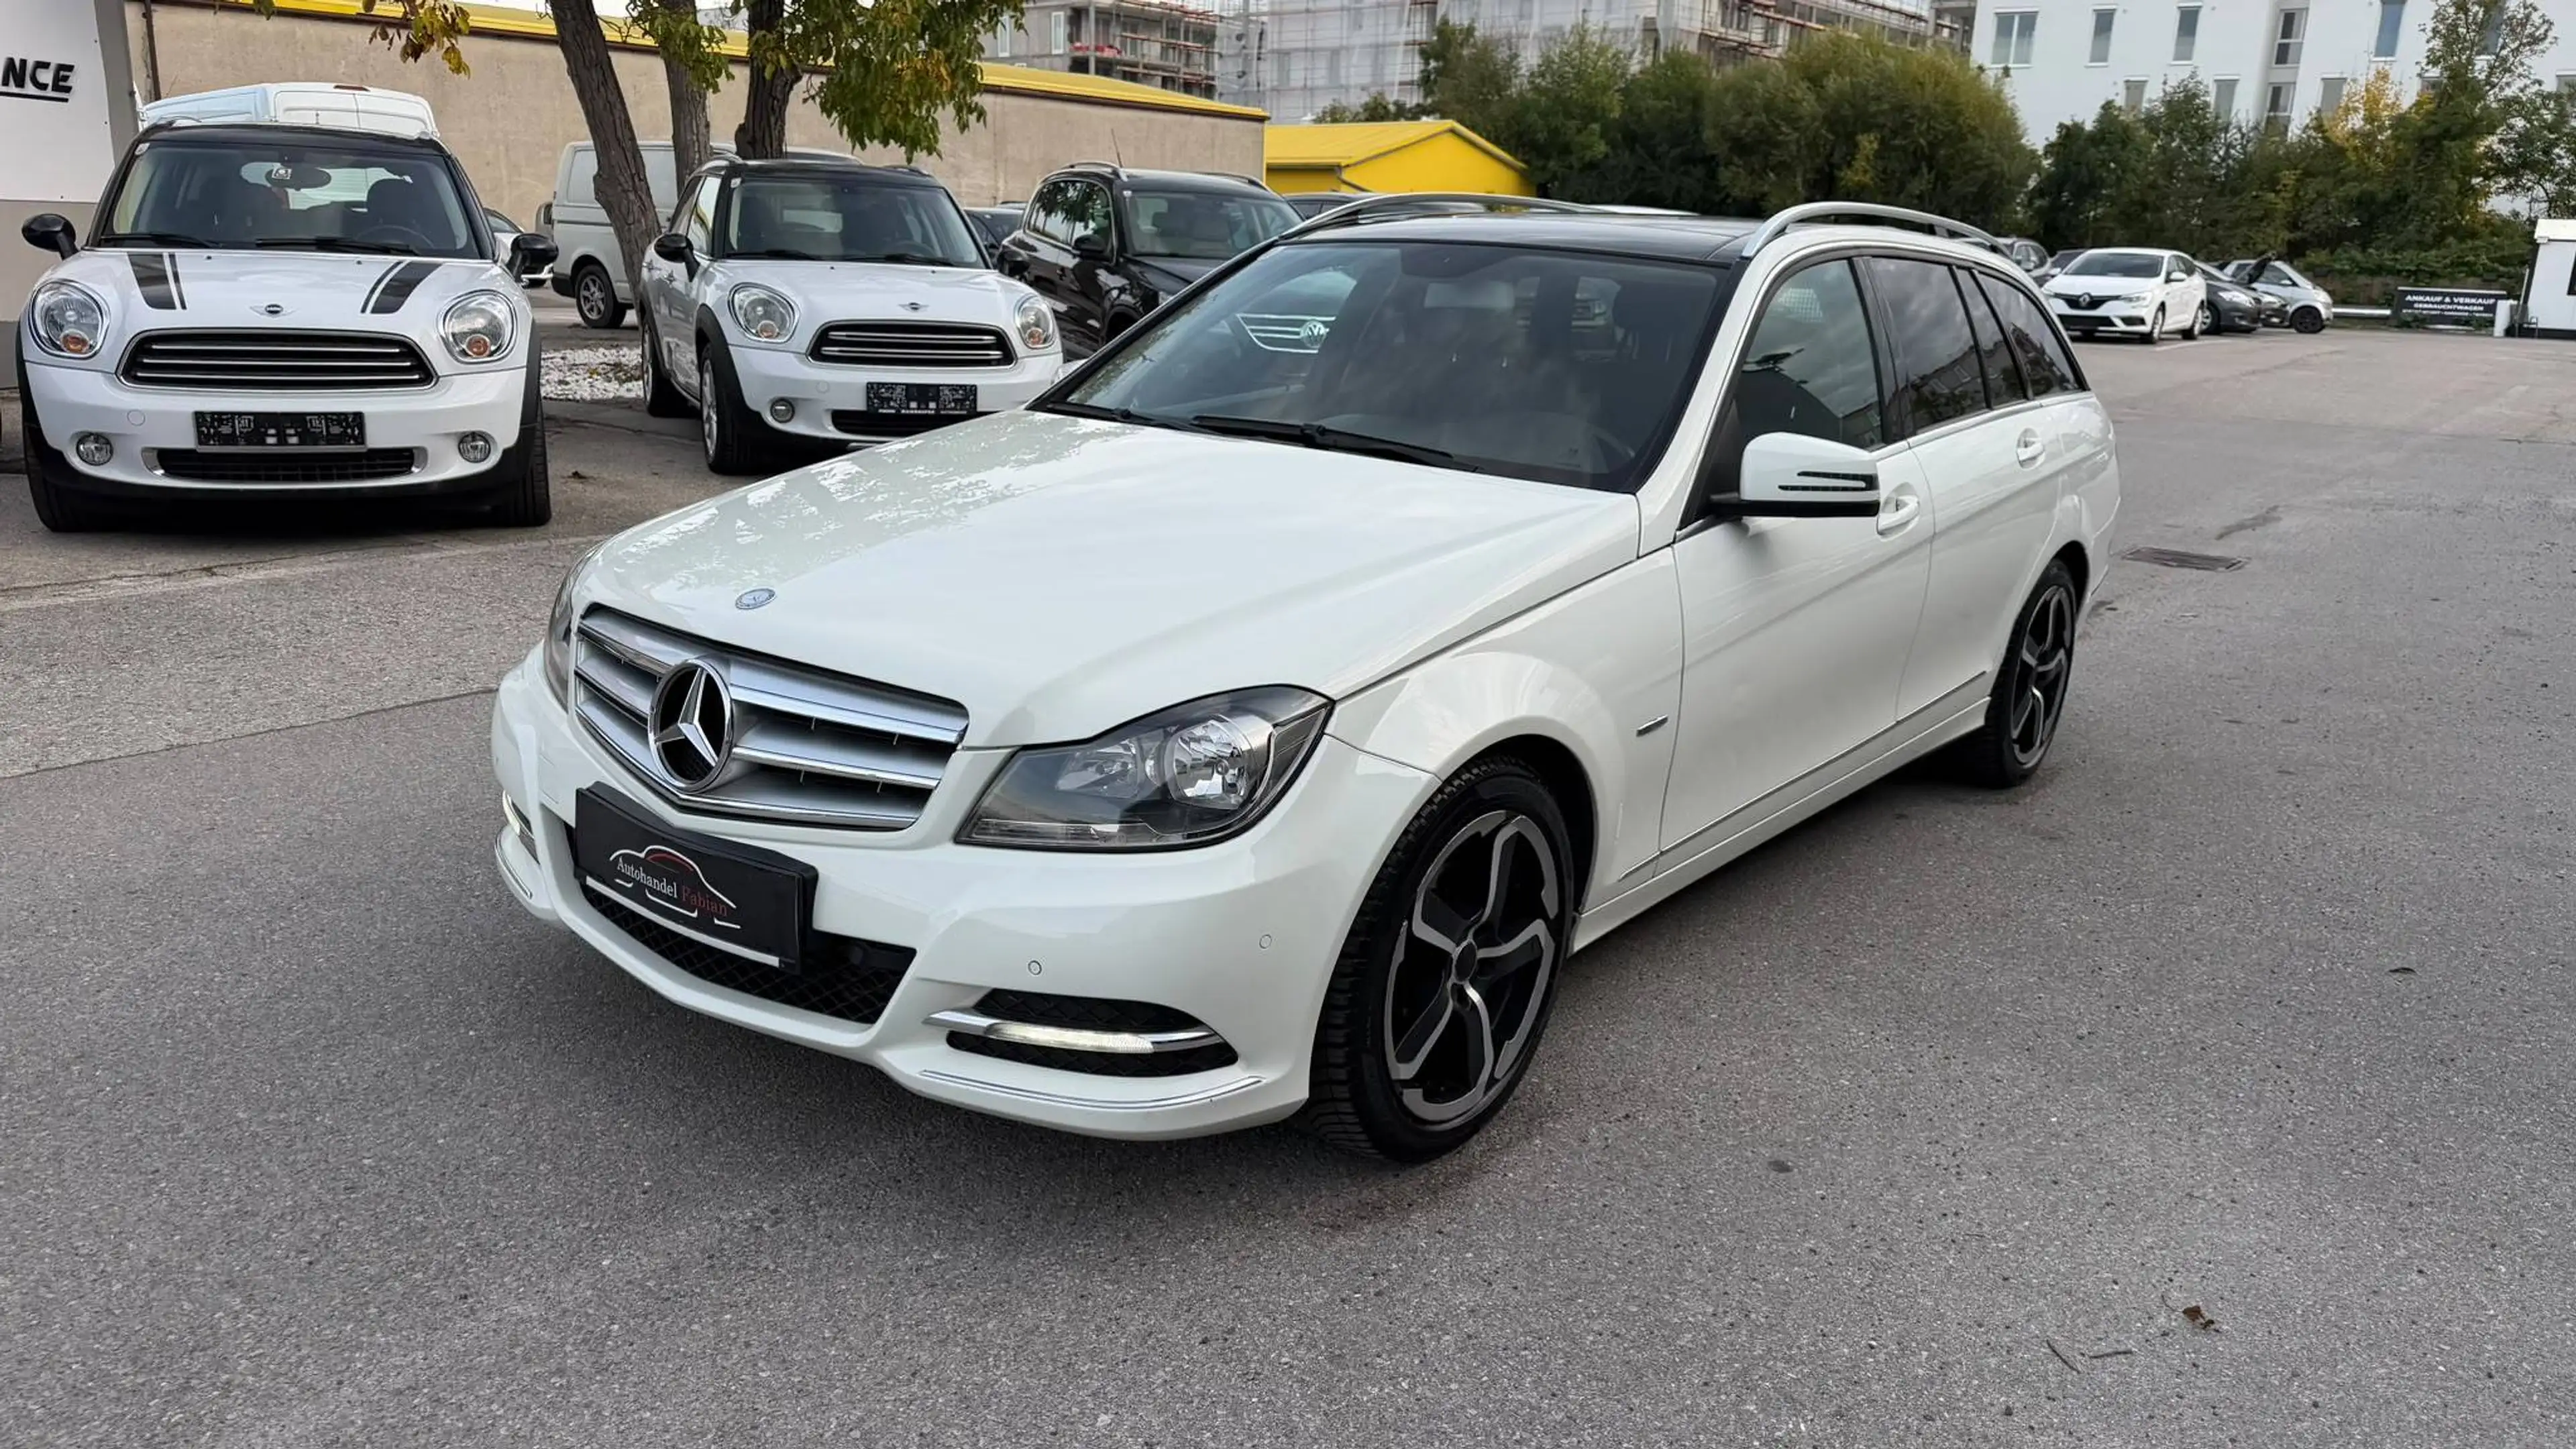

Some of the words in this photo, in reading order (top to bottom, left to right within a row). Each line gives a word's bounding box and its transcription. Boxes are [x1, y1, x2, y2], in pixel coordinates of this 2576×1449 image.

[1, 56, 76, 94] NCE
[2404, 294, 2443, 303] ANKAUF
[617, 855, 678, 899] Autohandel
[682, 885, 728, 916] Fabian
